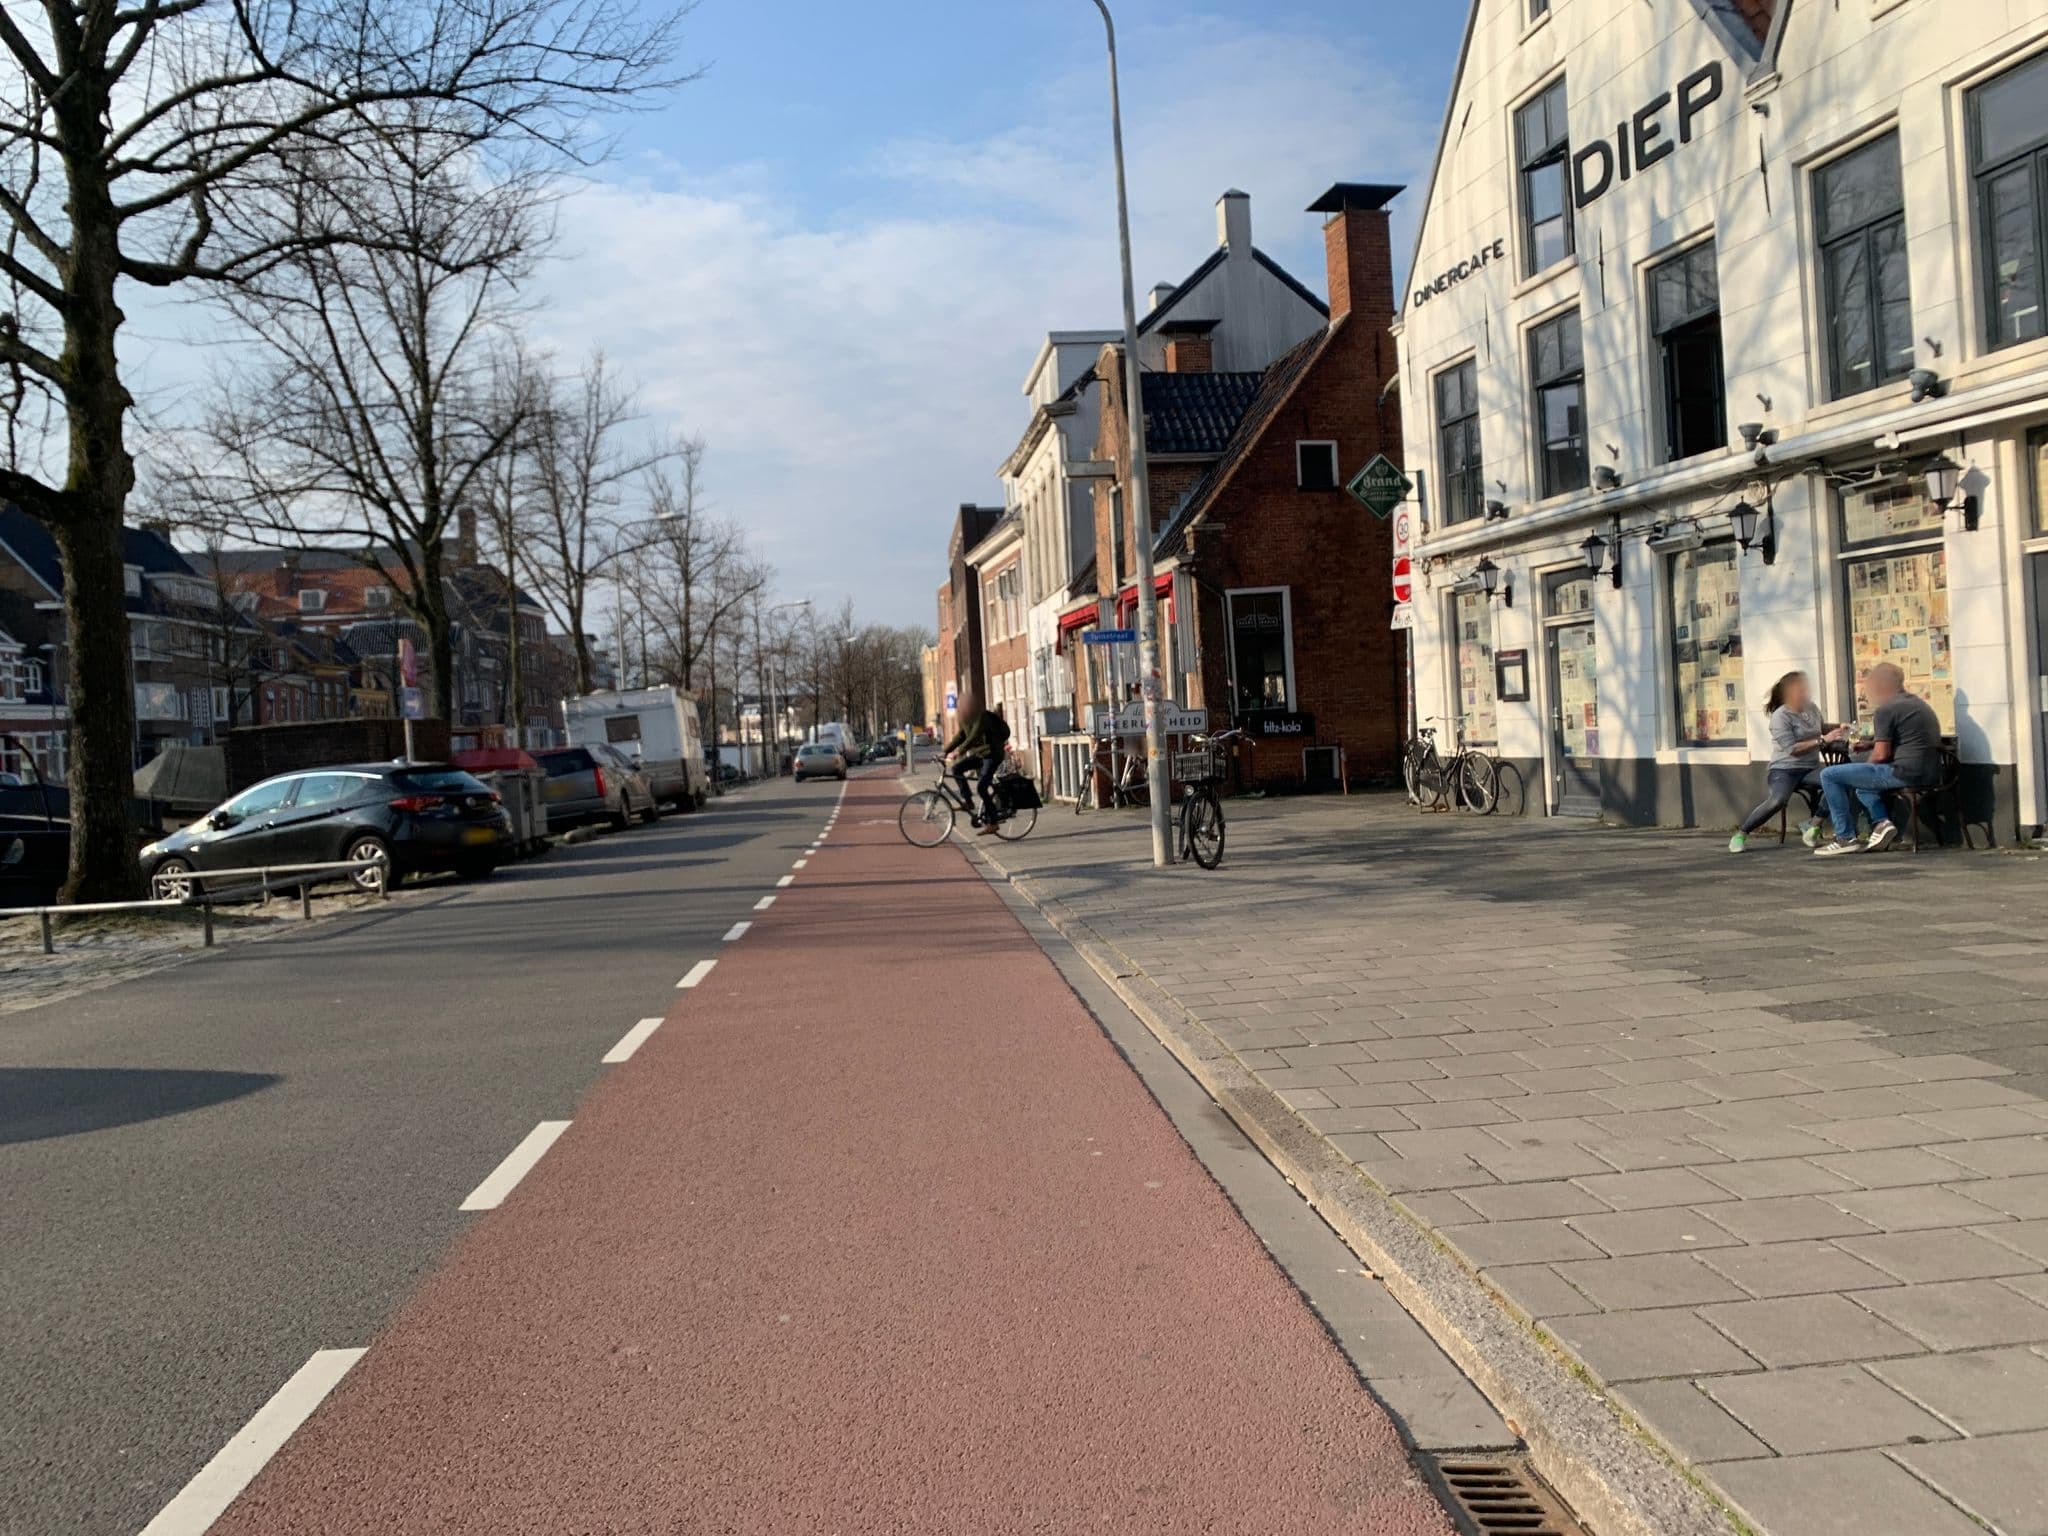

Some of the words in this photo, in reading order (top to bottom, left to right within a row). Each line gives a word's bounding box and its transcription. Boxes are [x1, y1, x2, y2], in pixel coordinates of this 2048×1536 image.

[1573, 60, 1722, 208] DIEP
[1414, 238, 1504, 308] DINERCAFE
[1103, 716, 1201, 730] HEERLHEID
